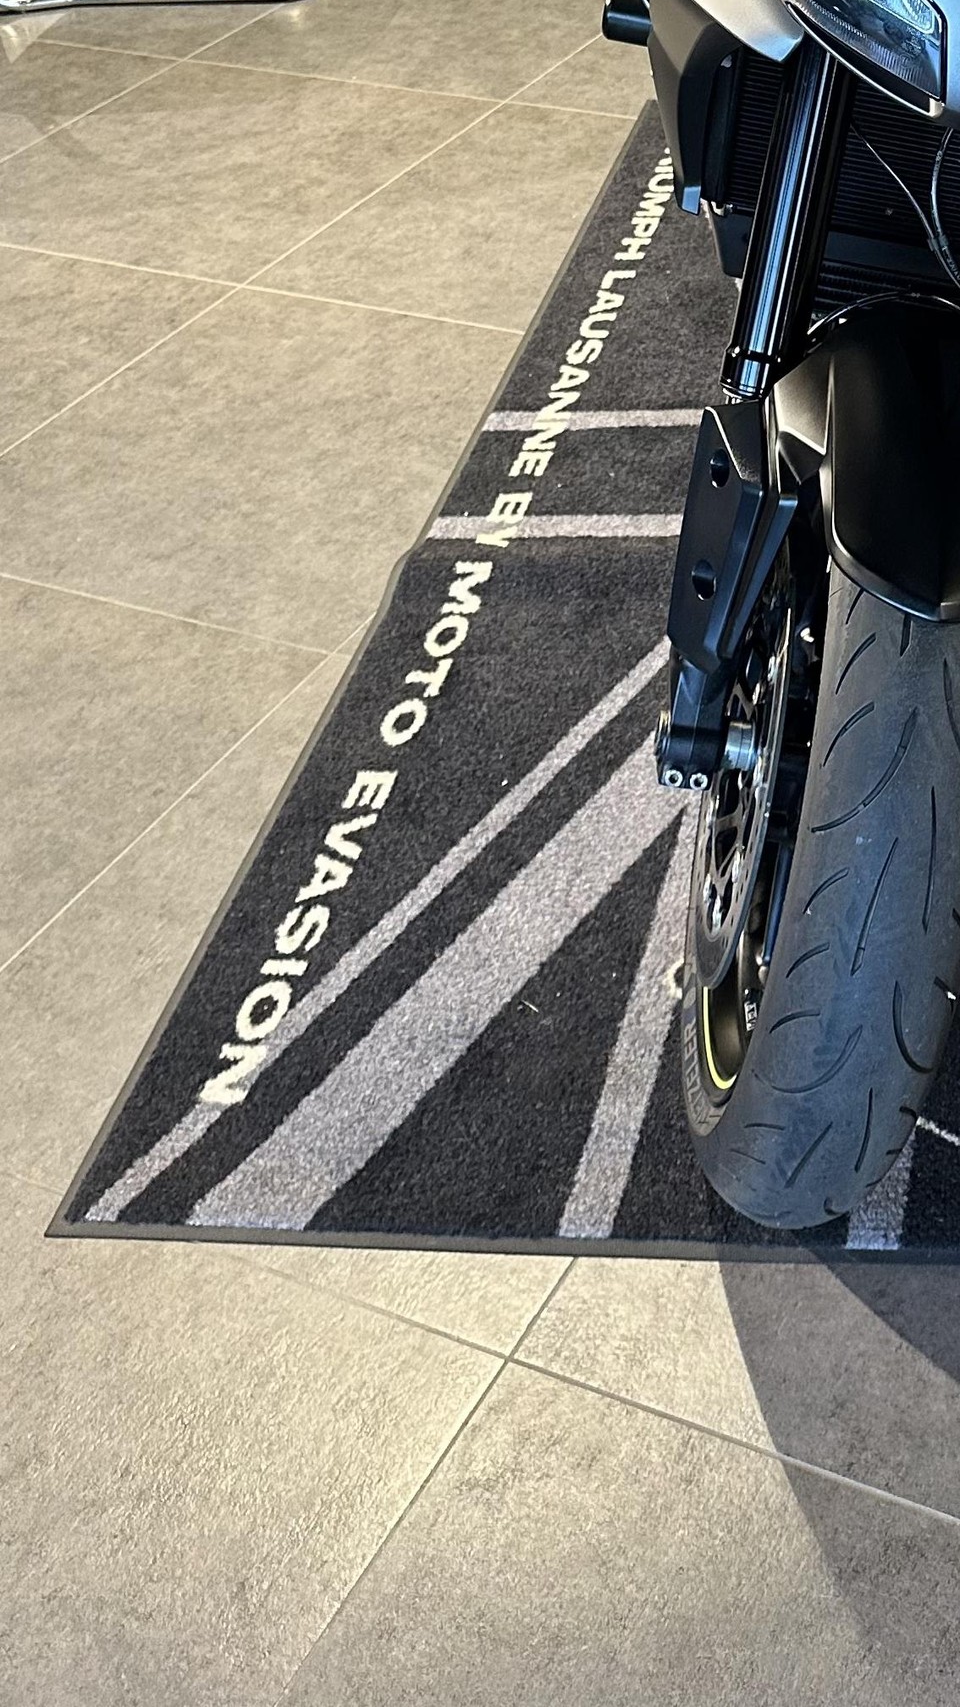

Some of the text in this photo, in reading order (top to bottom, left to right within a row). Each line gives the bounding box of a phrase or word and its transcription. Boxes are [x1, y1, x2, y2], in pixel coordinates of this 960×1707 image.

[199, 147, 675, 1105] IUMPH LAUSANNE BY MOTO EVASION
